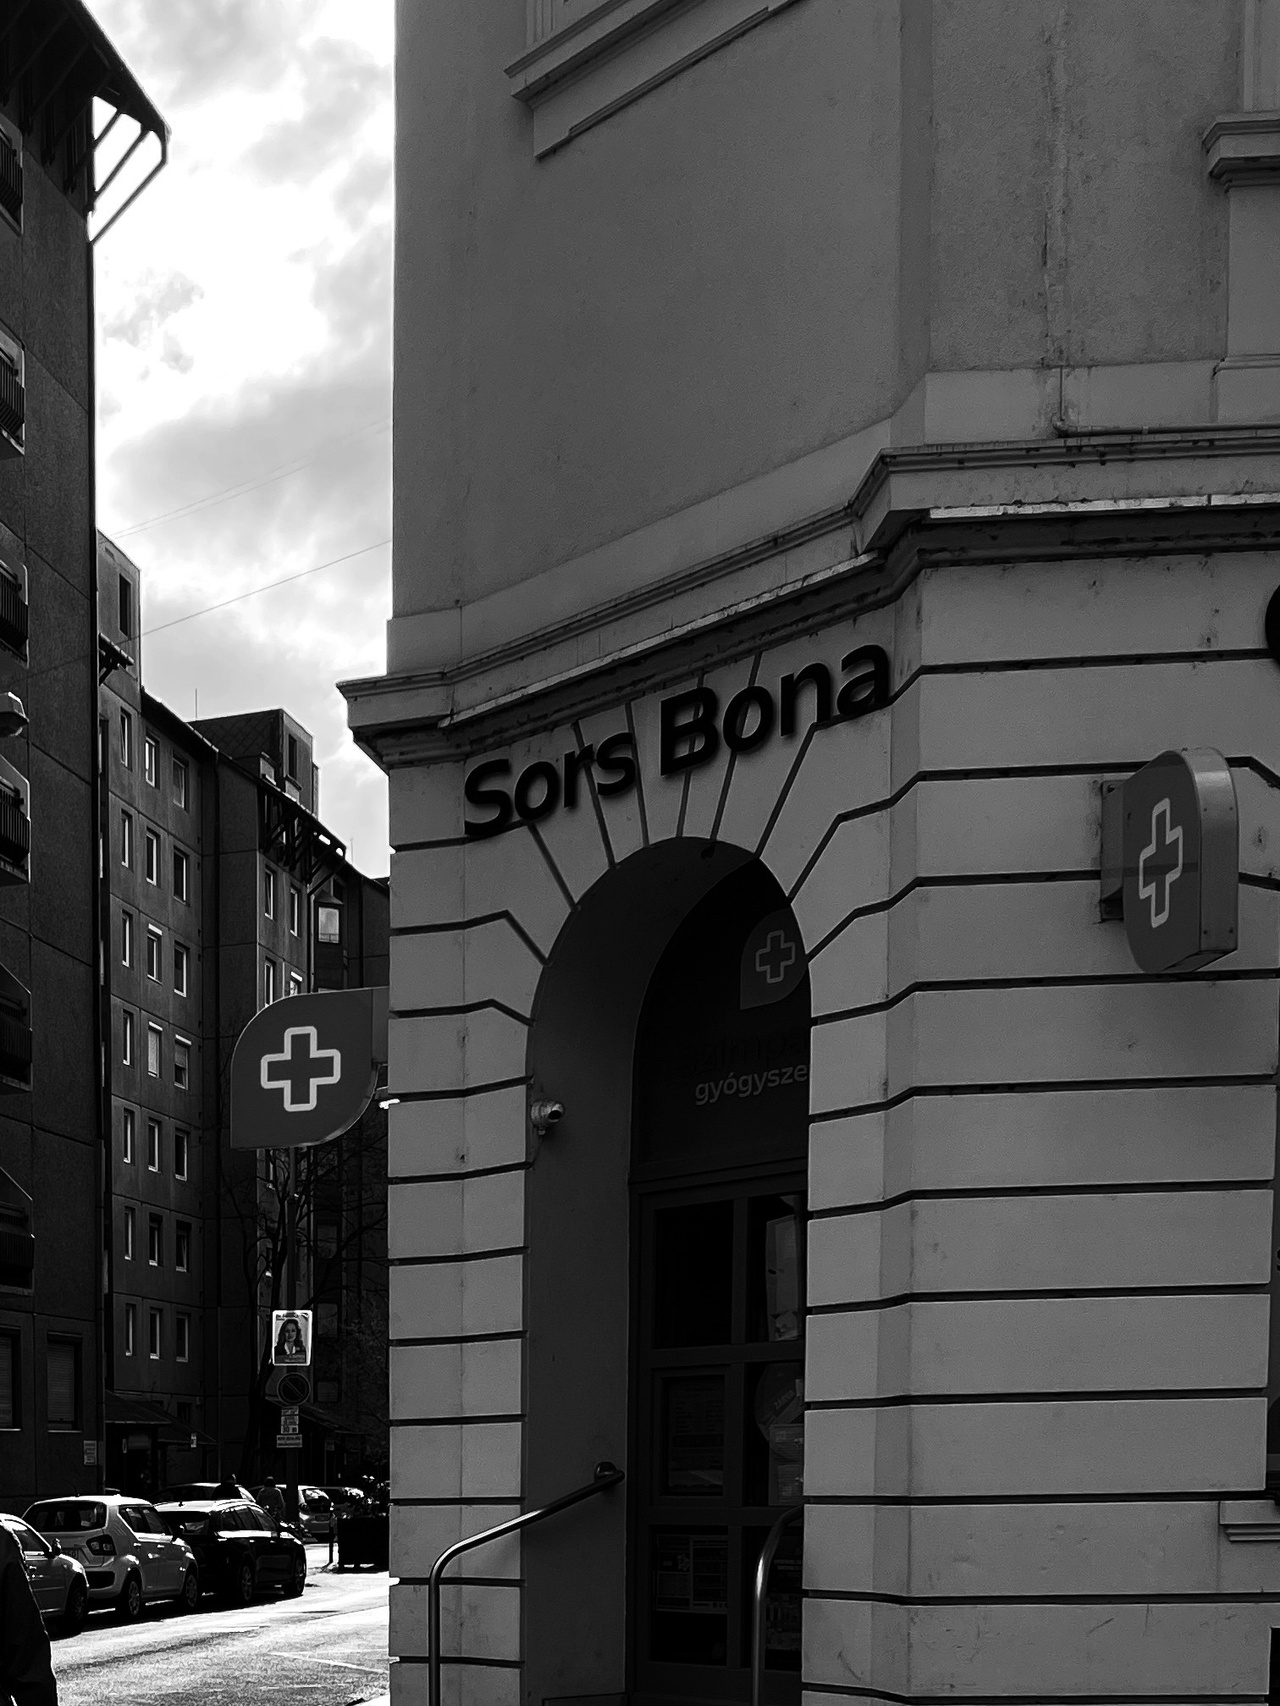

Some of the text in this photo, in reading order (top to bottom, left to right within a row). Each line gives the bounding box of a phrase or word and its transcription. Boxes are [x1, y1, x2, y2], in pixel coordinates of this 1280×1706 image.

[465, 644, 891, 837] Sors Bona
[695, 1064, 808, 1105] gyógysze
